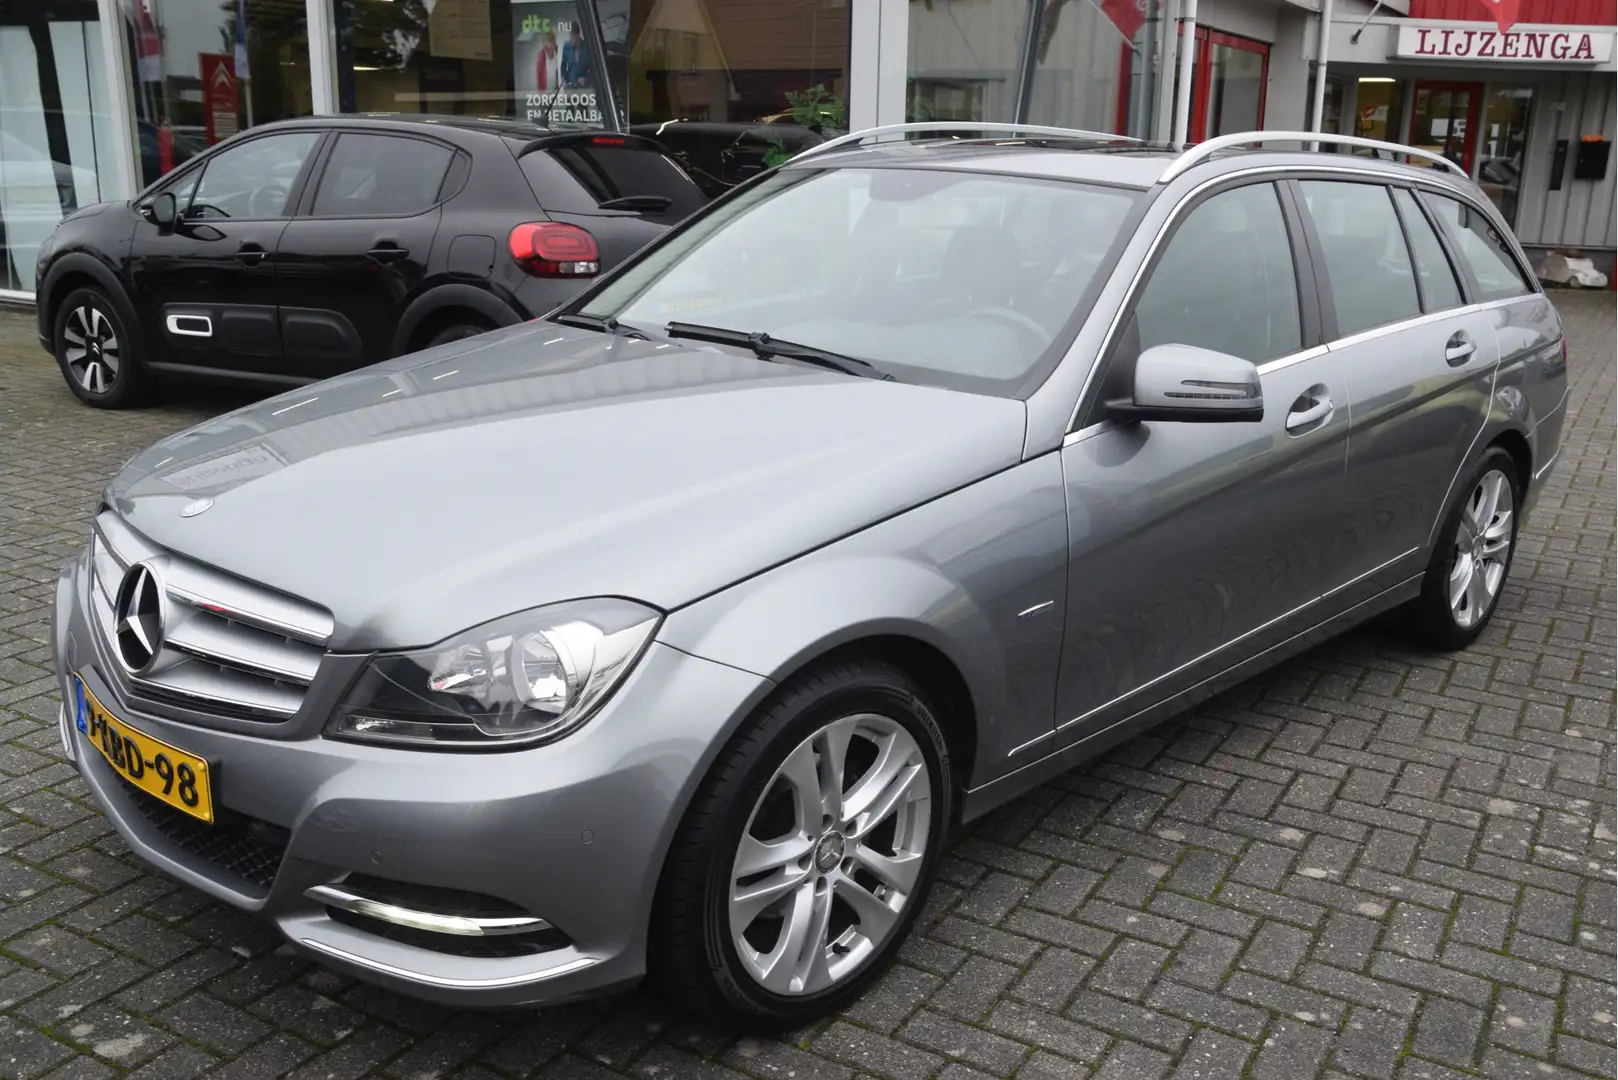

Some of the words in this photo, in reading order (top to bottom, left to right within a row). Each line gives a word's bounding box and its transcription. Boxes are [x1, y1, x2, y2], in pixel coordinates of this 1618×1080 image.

[558, 21, 572, 32] nu
[1415, 29, 1595, 59] LIJZENGA
[525, 93, 597, 106] ZORGELOOS
